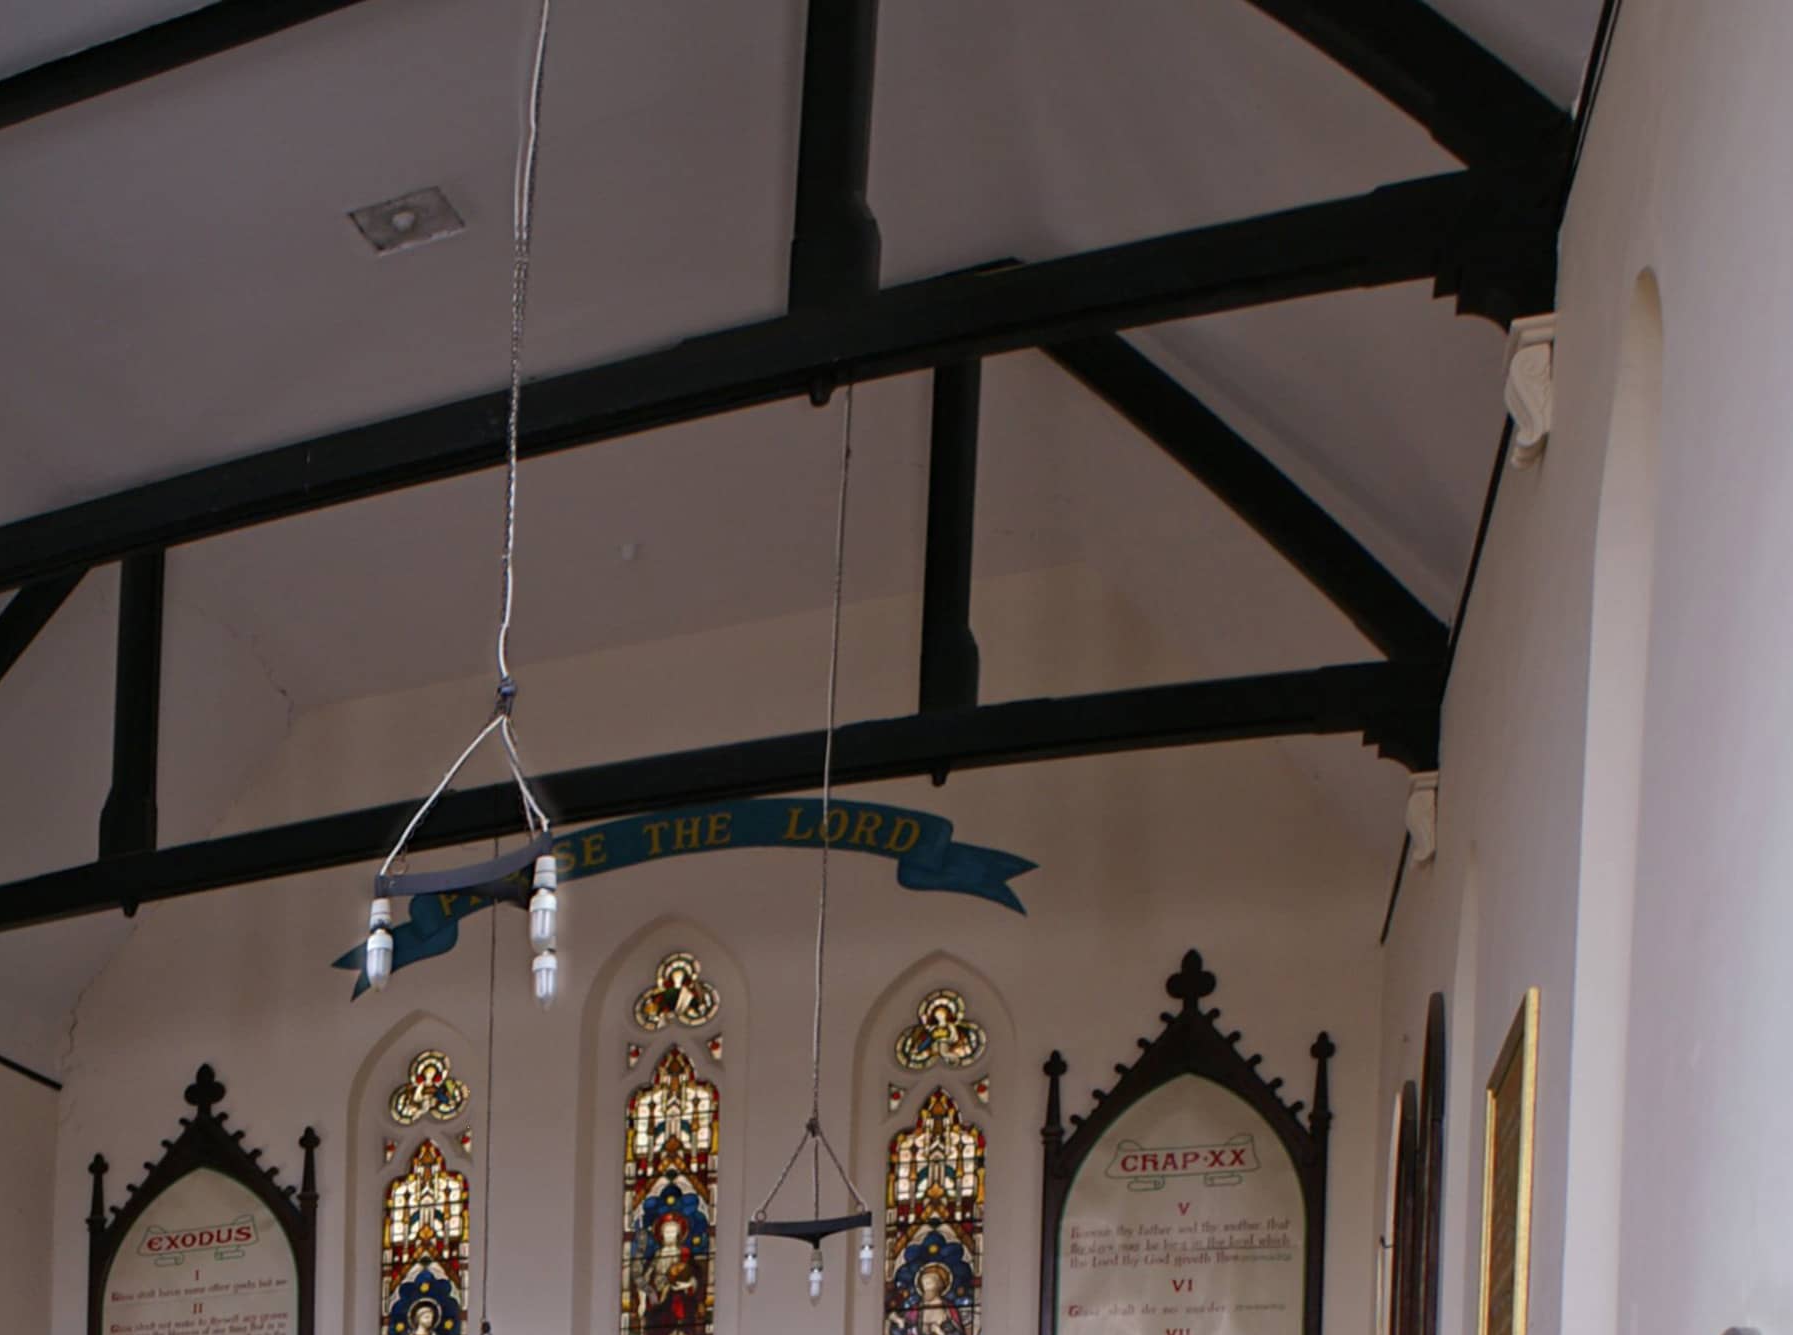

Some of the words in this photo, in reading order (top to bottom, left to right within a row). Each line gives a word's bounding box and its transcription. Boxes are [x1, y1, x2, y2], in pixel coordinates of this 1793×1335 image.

[643, 812, 733, 858] THE
[784, 807, 922, 854] LORD
[1177, 1202, 1190, 1215] V
[146, 1225, 253, 1252] EXODUS
[1172, 1278, 1193, 1293] VI
[192, 1302, 204, 1315] II
